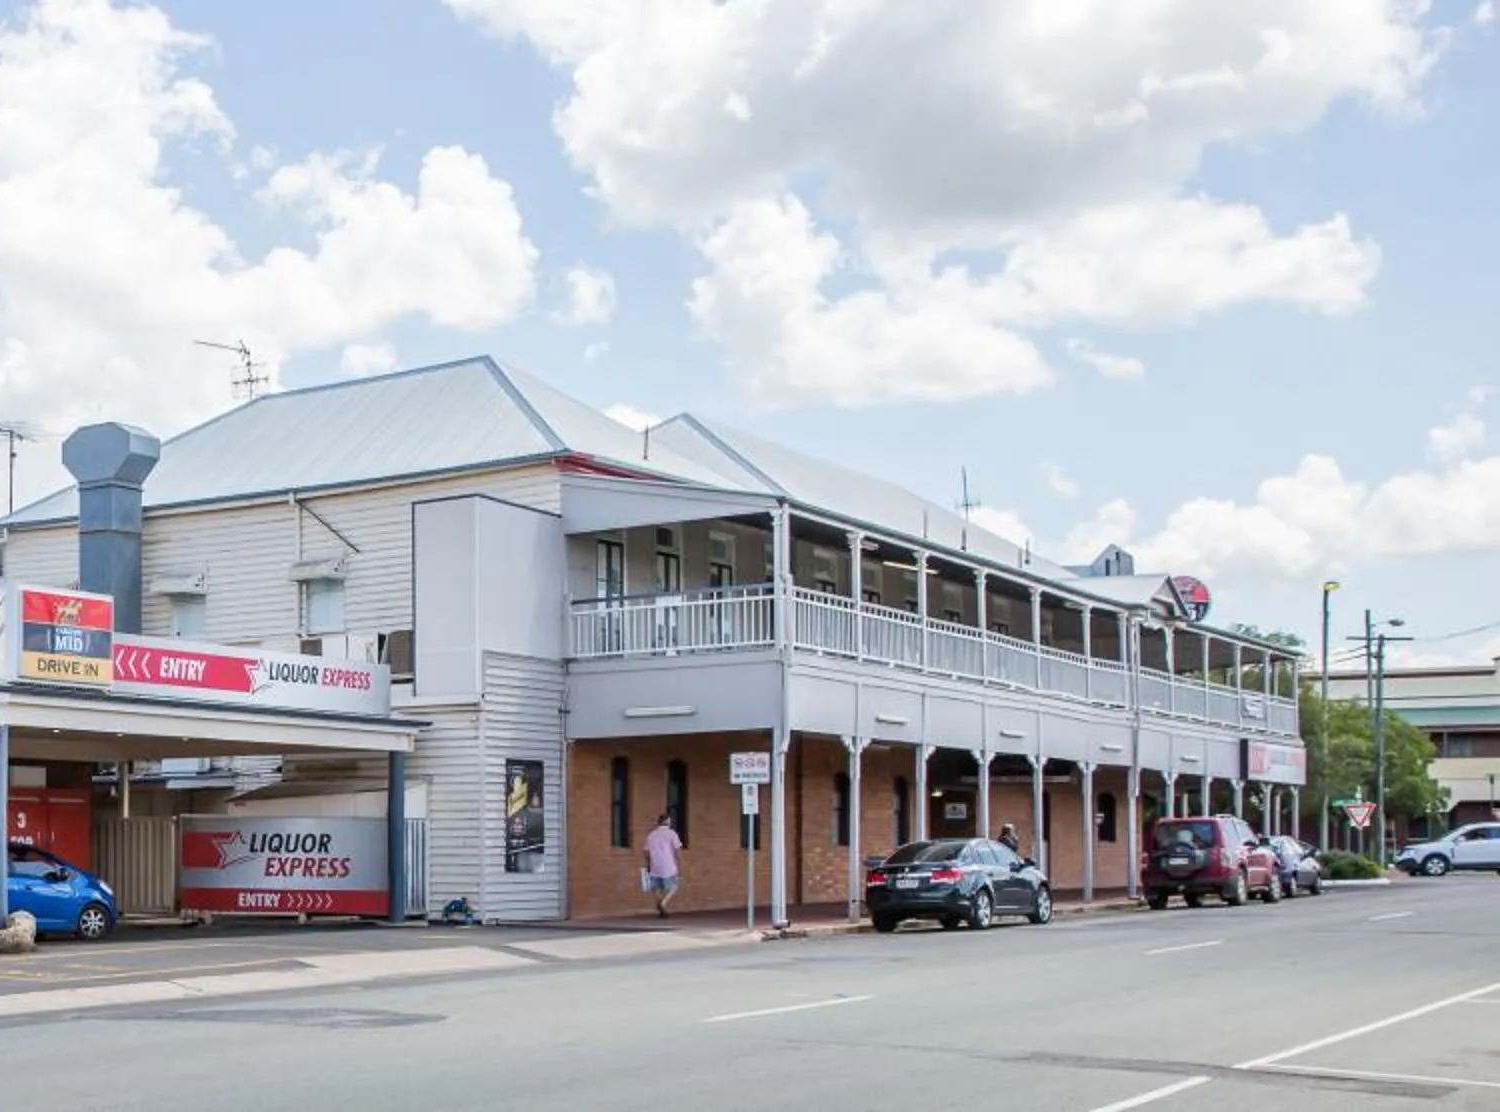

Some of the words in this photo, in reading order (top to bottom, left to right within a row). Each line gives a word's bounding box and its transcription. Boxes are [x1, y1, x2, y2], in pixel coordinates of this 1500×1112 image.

[55, 635, 83, 652] MID
[36, 658, 80, 675] DRIVE
[84, 663, 99, 677] IN
[159, 656, 206, 681] ENTRY
[269, 661, 319, 685] LIQUOR
[321, 667, 372, 690] EXPRESS
[249, 833, 332, 854] LIQUOR
[264, 857, 352, 878] EXPRESS
[238, 892, 281, 908] ENTRY
